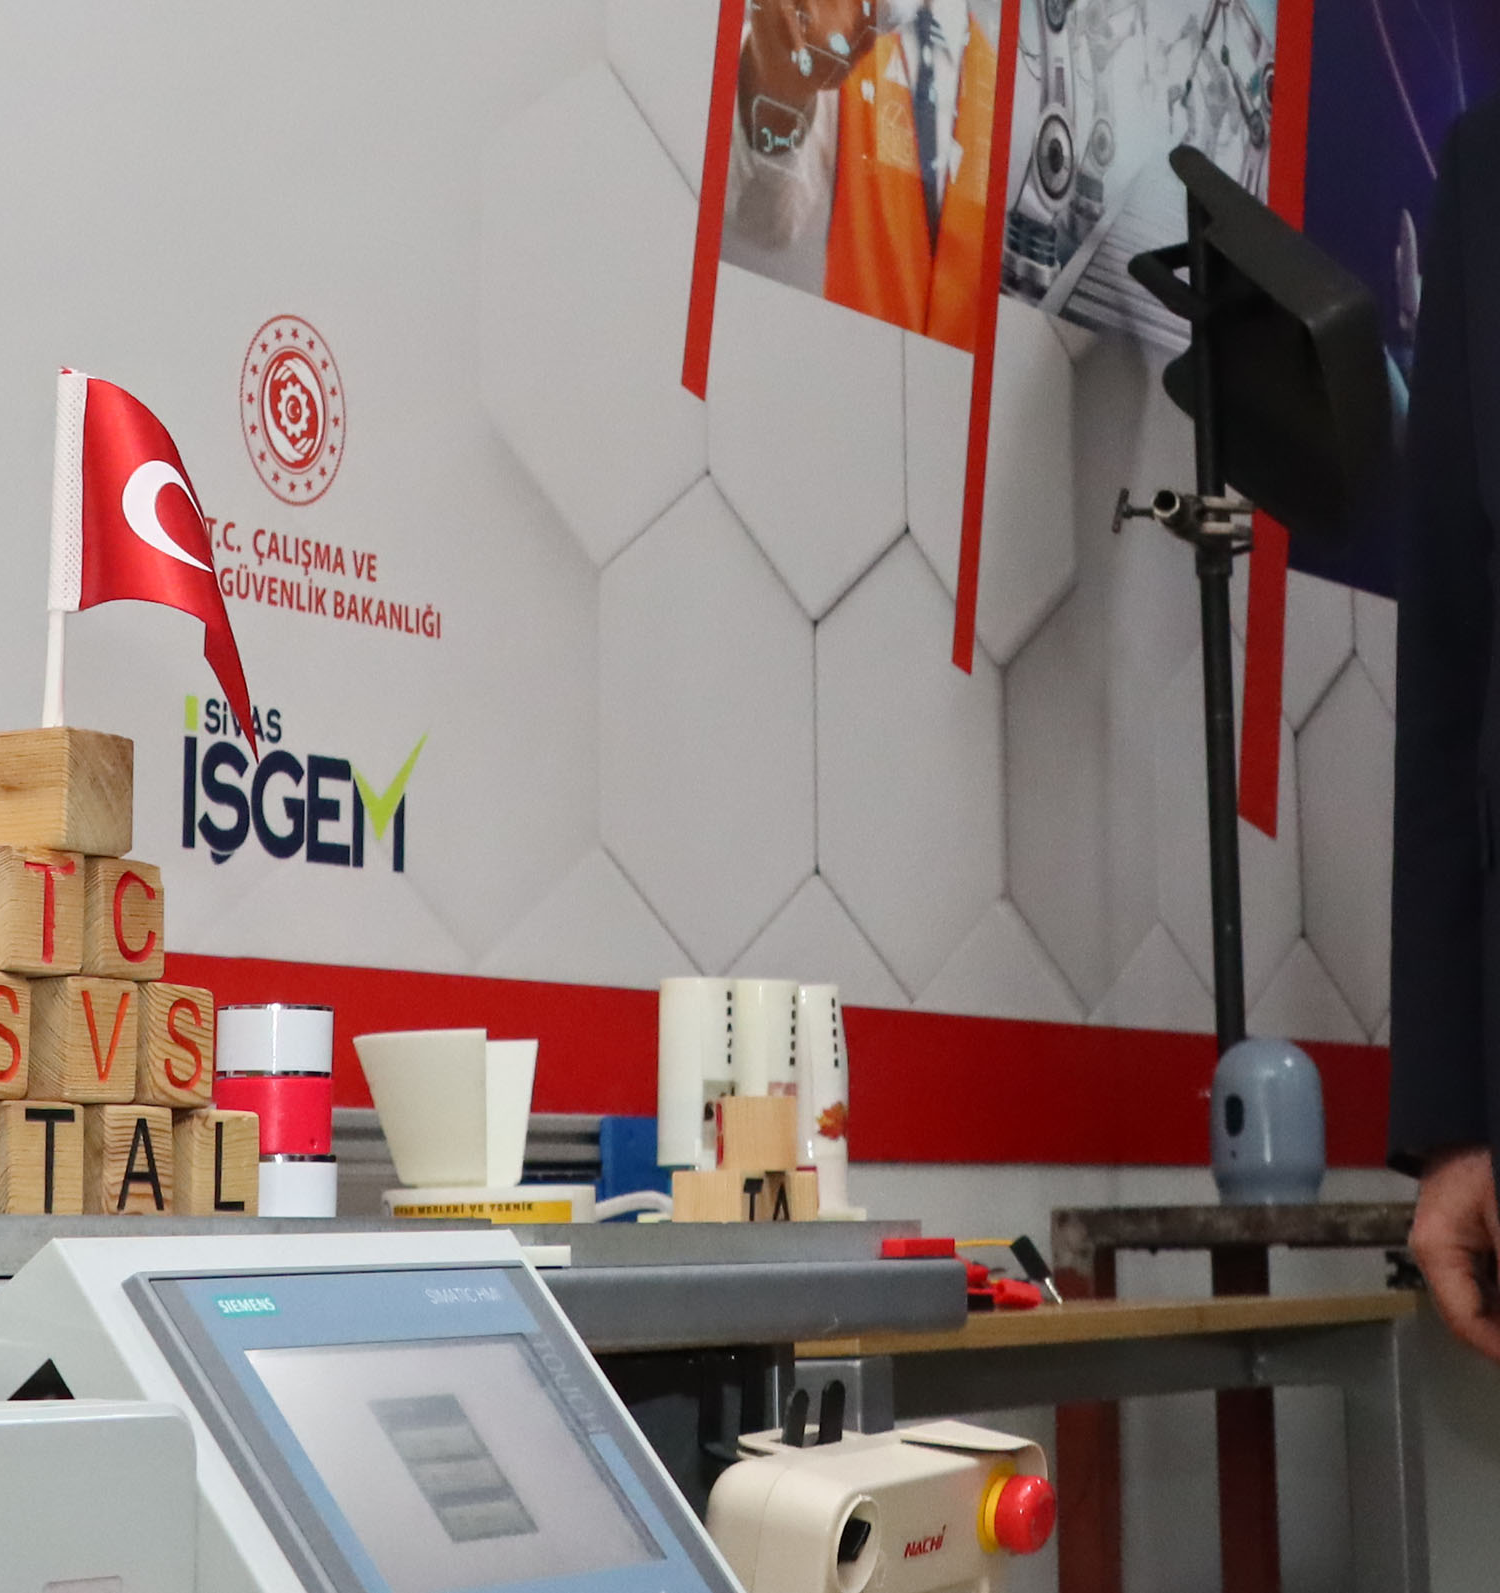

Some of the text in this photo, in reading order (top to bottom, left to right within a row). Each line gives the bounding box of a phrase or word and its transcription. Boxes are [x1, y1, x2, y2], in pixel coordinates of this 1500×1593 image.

[252, 528, 346, 576] ÇALIŞMA
[352, 550, 377, 582] VE
[219, 563, 441, 639] GÜVENLİK BAKANLIĞI
[217, 1296, 276, 1314] SIEMENS
